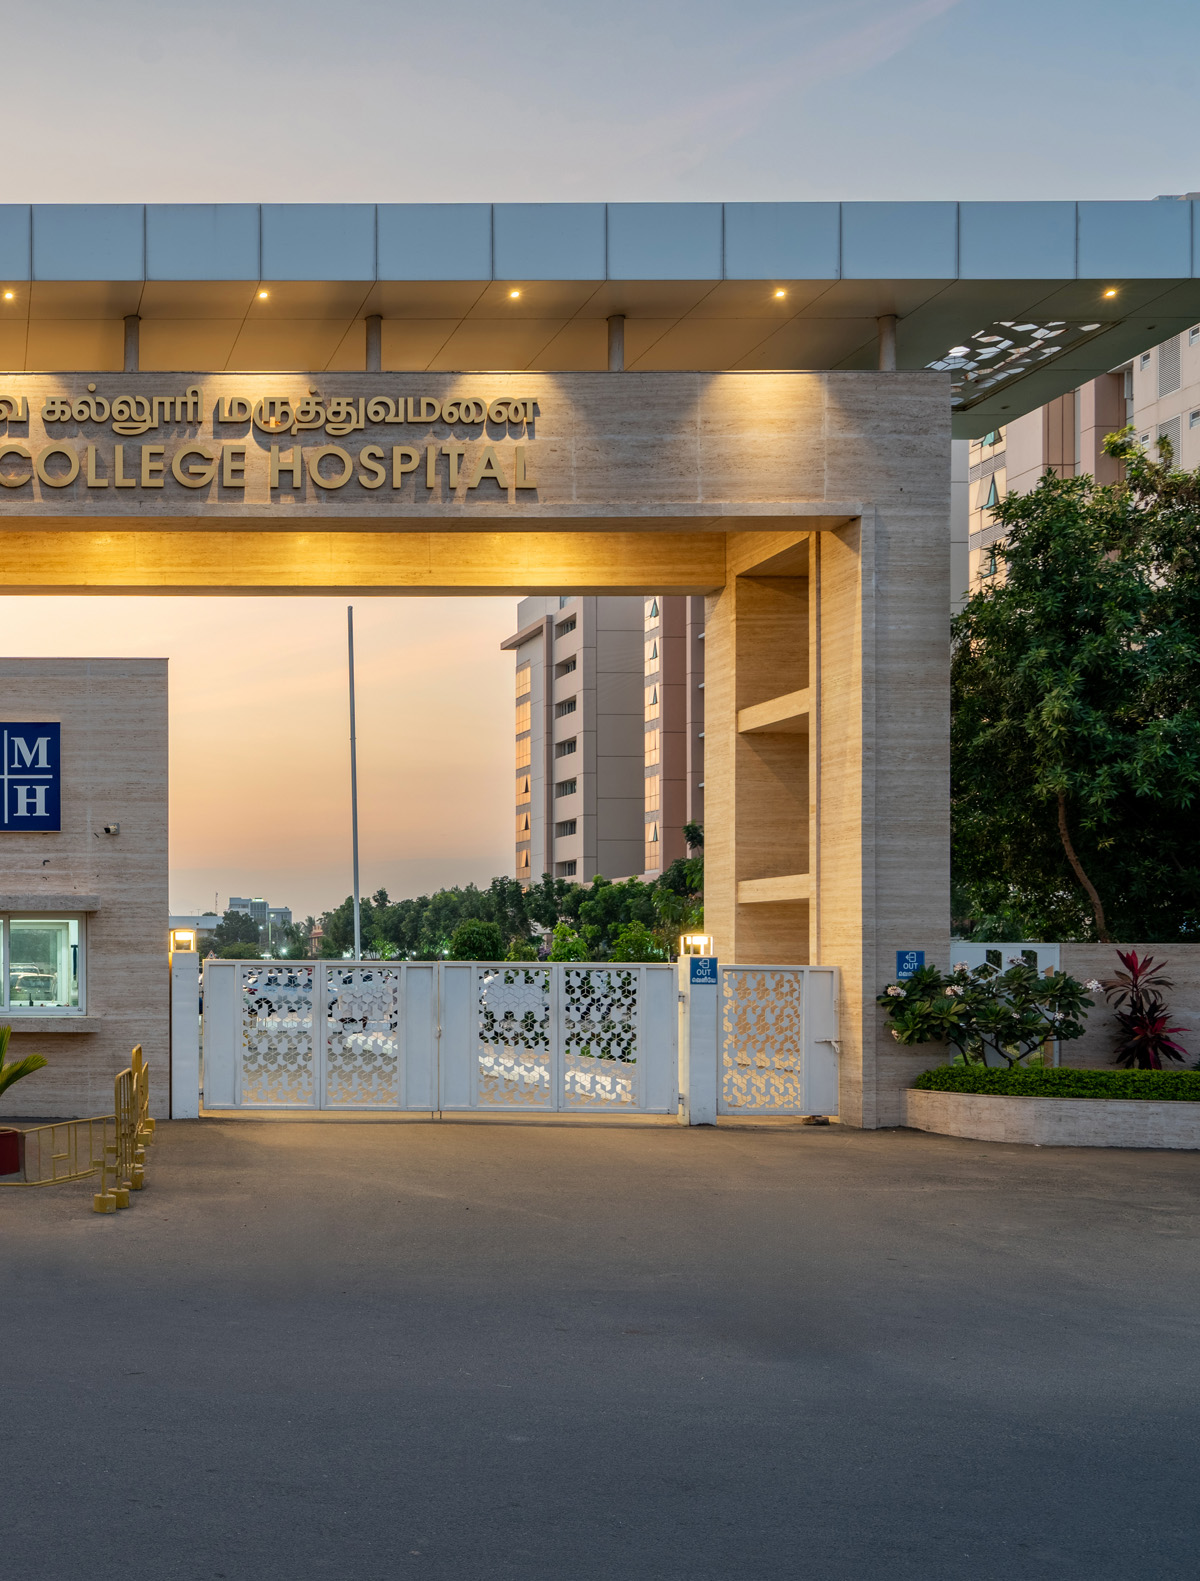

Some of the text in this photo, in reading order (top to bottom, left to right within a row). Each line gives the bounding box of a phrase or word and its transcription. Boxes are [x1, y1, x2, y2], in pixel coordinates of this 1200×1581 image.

[41, 383, 203, 436] கல்லூரி
[218, 385, 538, 437] மருத்துவமனை
[270, 445, 538, 490] HOSPITAL
[903, 962, 918, 970] OUT
